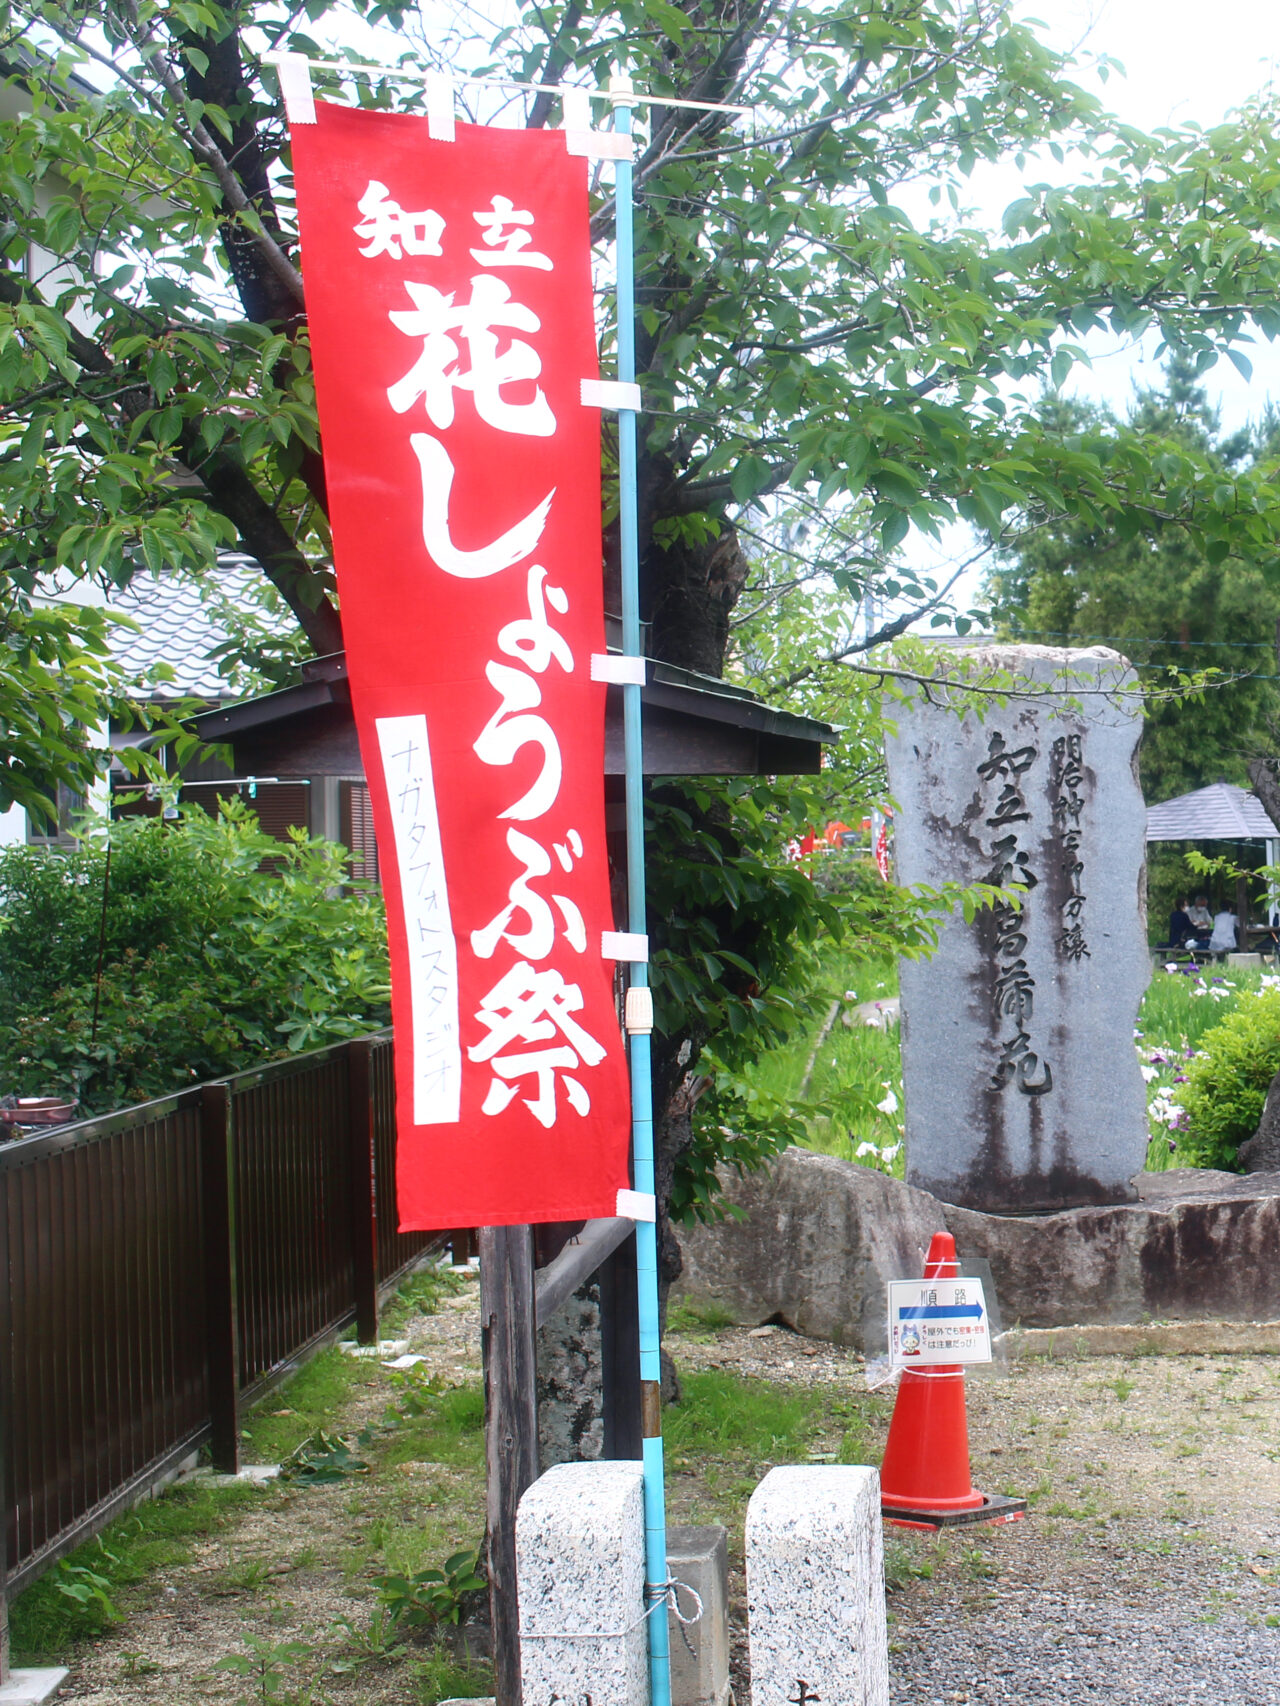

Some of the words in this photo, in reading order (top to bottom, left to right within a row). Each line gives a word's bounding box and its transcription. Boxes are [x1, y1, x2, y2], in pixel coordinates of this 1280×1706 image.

[353, 180, 553, 271] 知立
[386, 273, 607, 1129] 花しょうぶ祭
[391, 739, 453, 1095] ナガタフォトスタジオ
